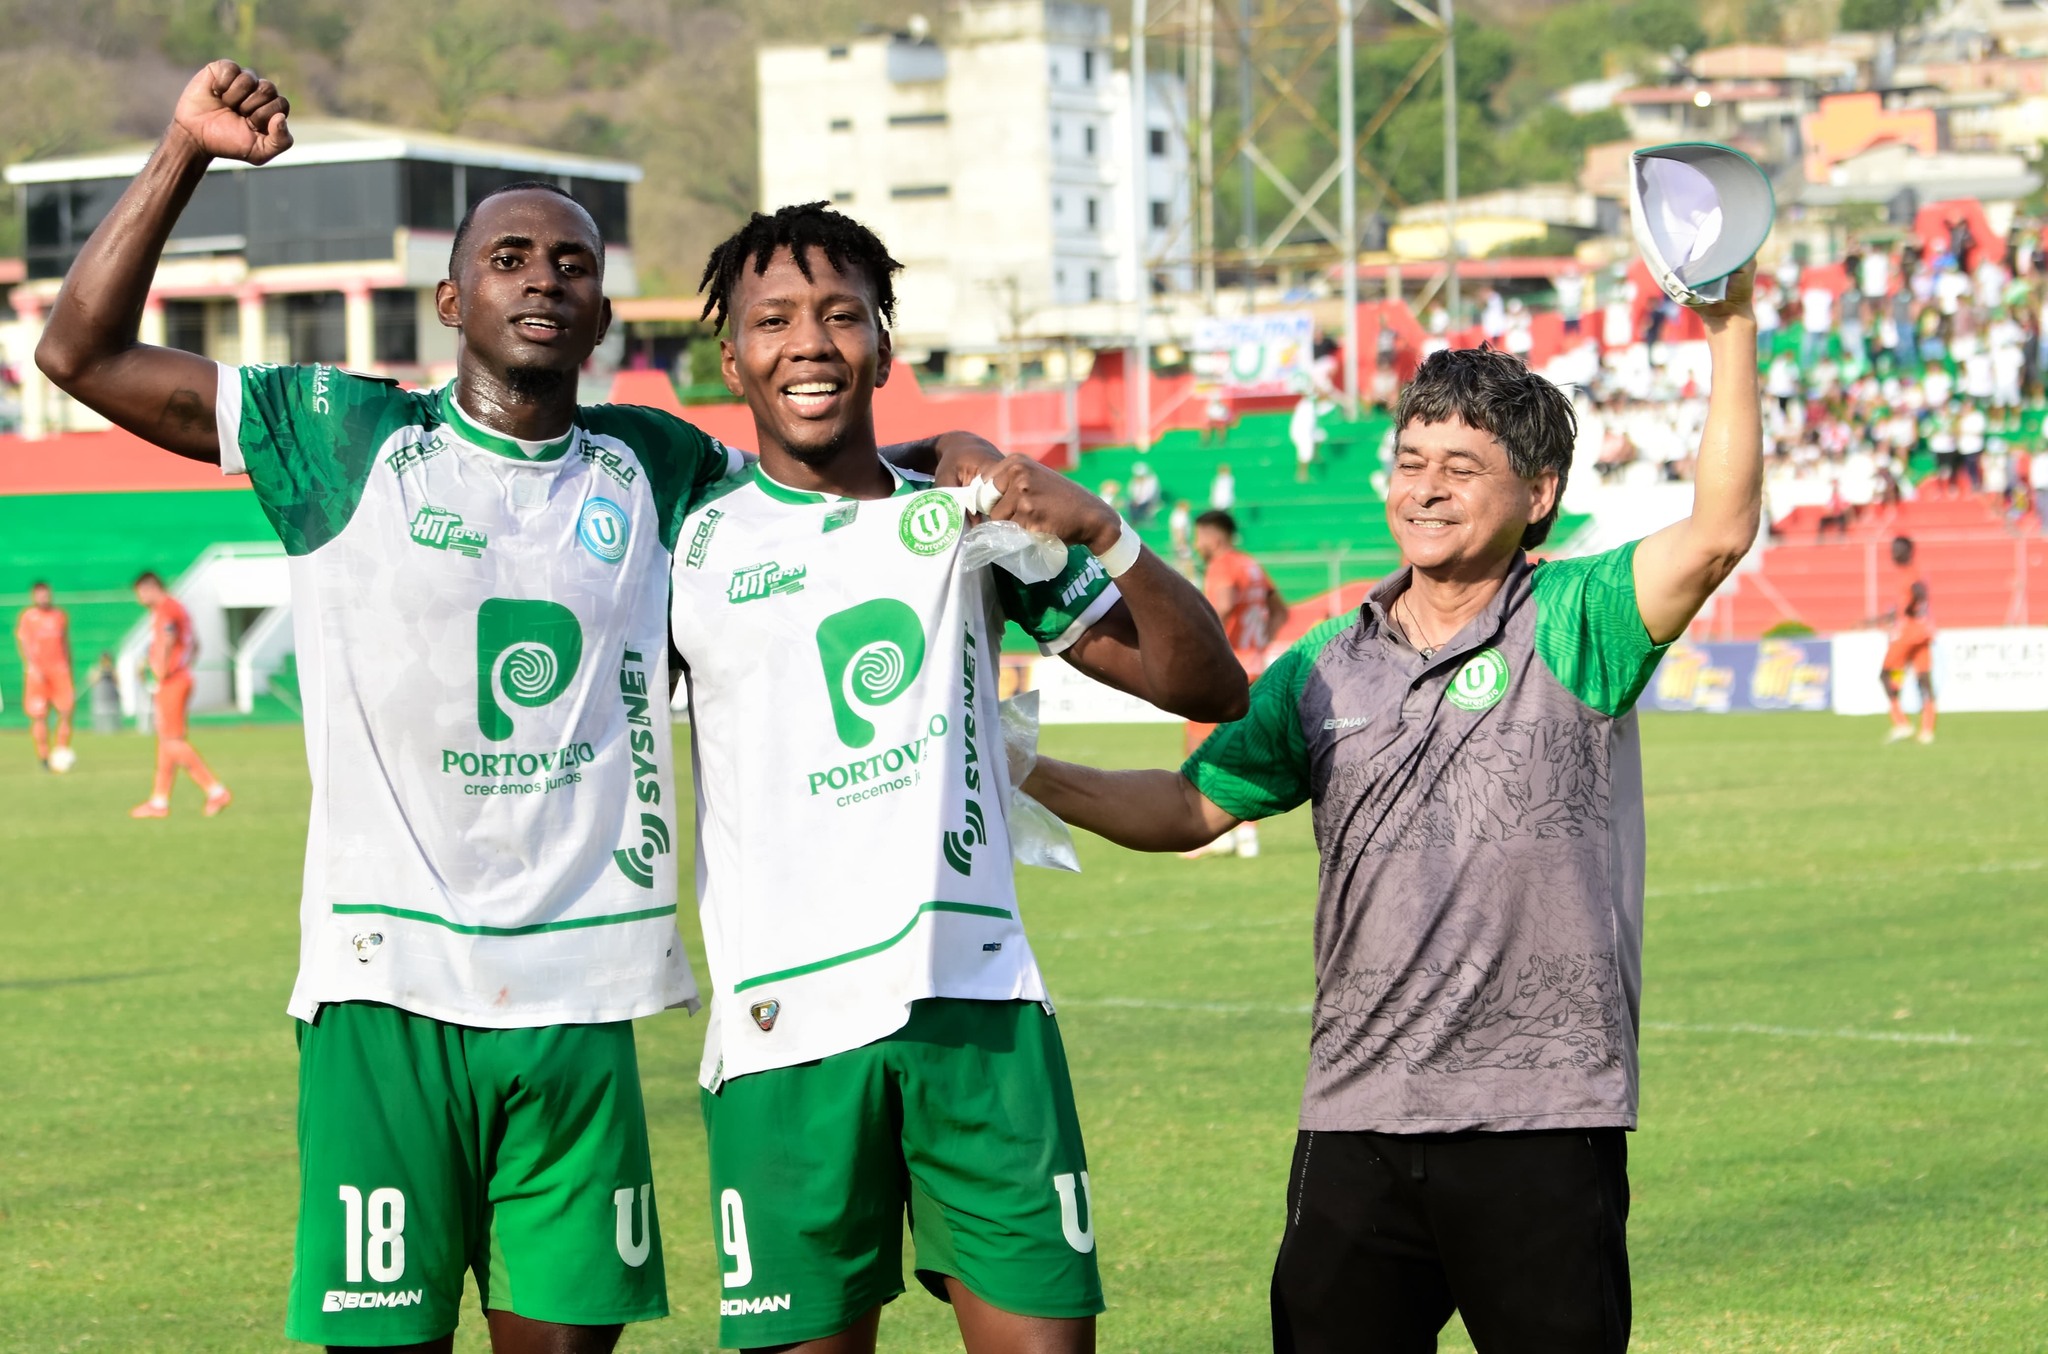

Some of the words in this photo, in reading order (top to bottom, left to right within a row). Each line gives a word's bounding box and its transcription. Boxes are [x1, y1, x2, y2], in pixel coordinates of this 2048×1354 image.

[412, 511, 462, 545] HIT
[448, 527, 486, 543] 104.1
[592, 516, 616, 546] U
[686, 508, 721, 567] TECGLO
[917, 508, 941, 537] U
[729, 562, 778, 600] HIT
[767, 564, 806, 583] 104.1
[1465, 664, 1485, 691] U
[619, 643, 661, 806] SYSNET
[963, 622, 981, 796] SYSNET
[441, 742, 595, 777] PORTOVIEJO
[464, 781, 541, 796] crecemos
[836, 775, 912, 808] crecemos
[613, 1182, 651, 1268] U
[1053, 1171, 1095, 1254] U
[339, 1184, 406, 1283] 18
[720, 1188, 752, 1289] 9
[343, 1289, 423, 1311] BOMAN
[720, 1294, 791, 1316] BOMAN
